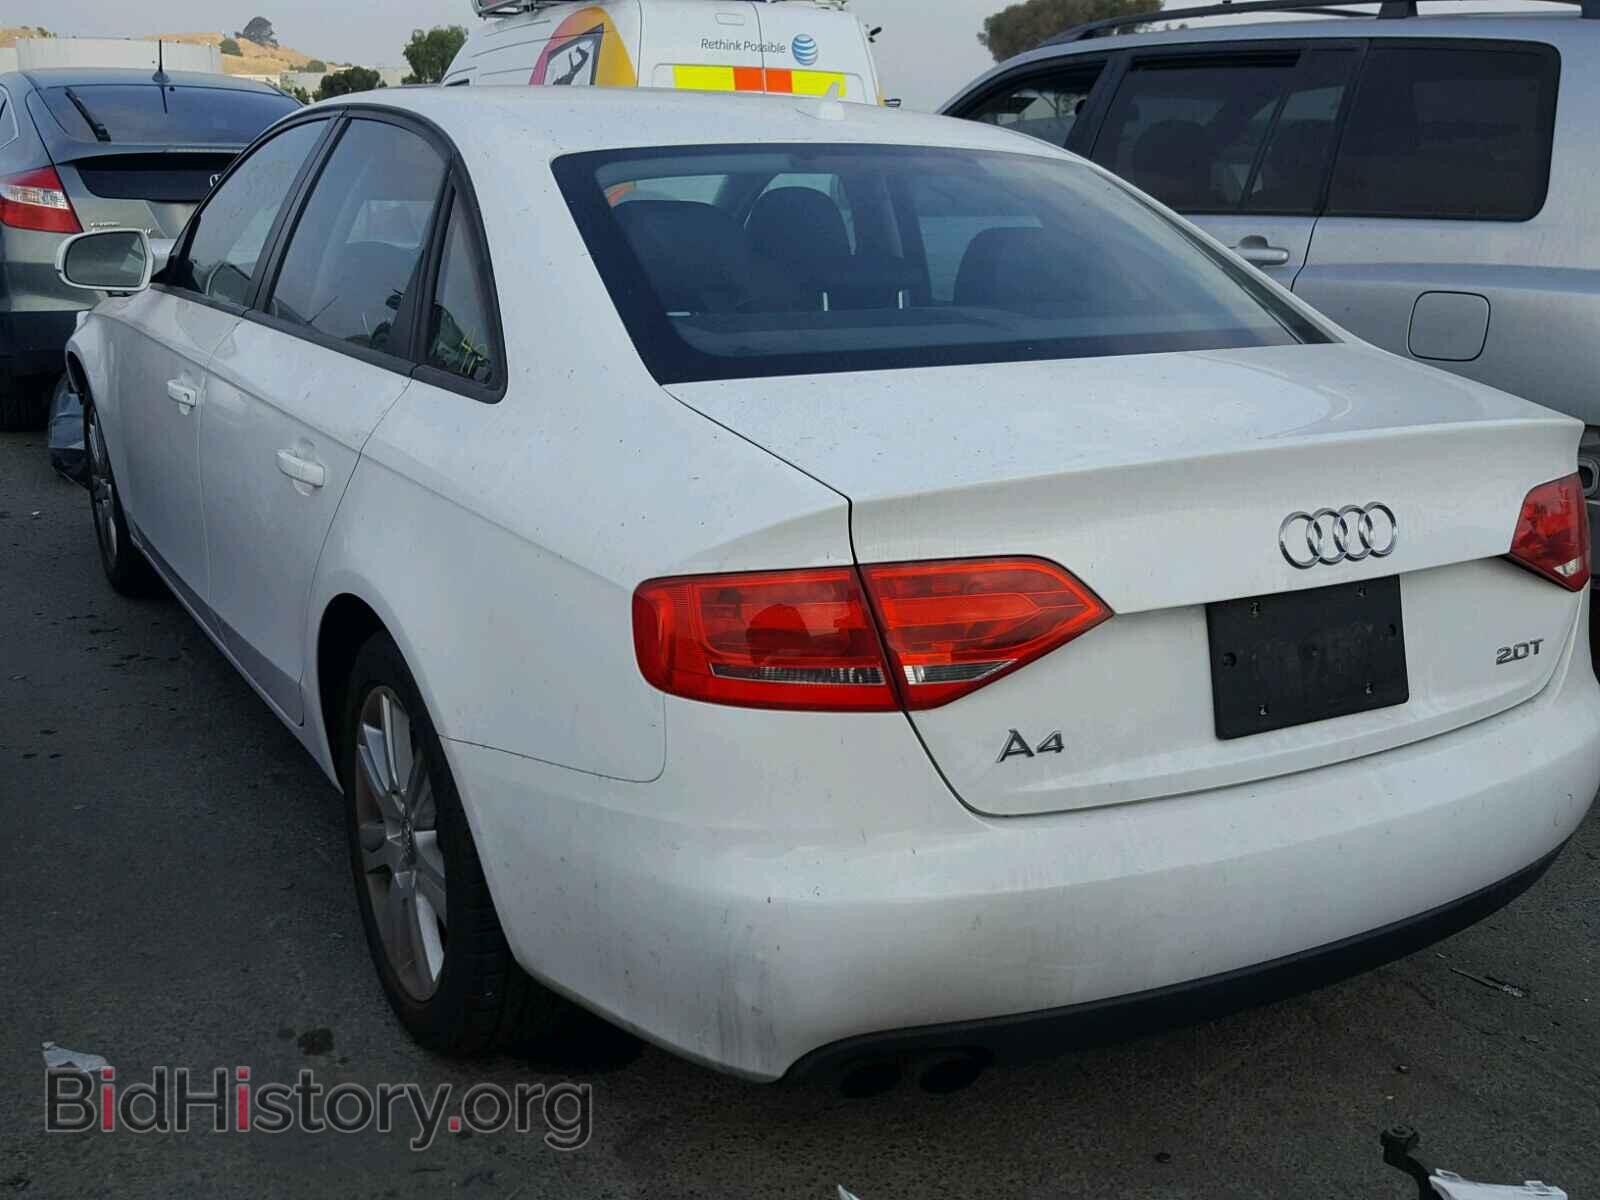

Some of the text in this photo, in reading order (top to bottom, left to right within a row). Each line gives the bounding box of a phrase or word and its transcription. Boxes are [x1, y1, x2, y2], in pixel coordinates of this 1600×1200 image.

[701, 38, 786, 53] Rethink Possible
[995, 729, 1065, 764] A4
